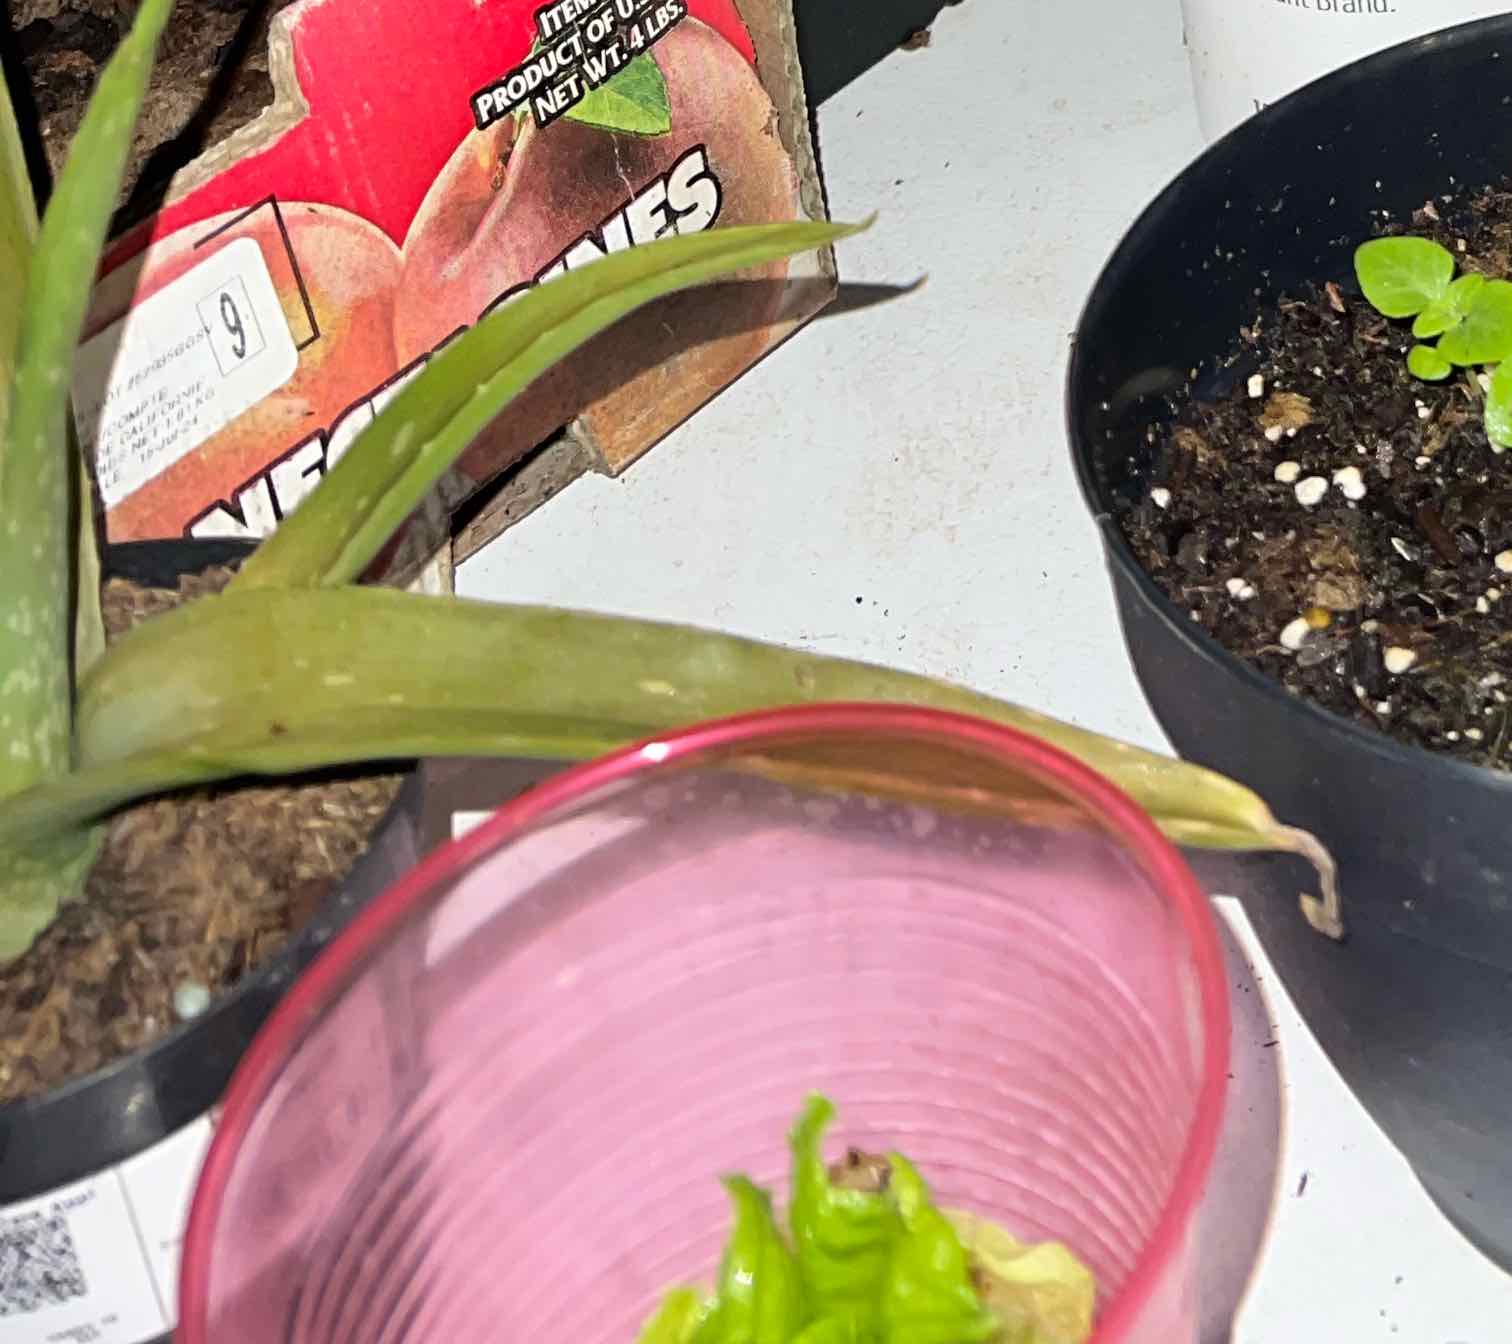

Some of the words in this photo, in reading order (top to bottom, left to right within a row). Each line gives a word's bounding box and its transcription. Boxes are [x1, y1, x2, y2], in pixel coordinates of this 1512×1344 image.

[476, 33, 581, 123] PRODUCT
[586, 13, 615, 43] OF
[535, 75, 580, 121] NET
[583, 42, 628, 83] WT.
[630, 24, 645, 49] 4
[219, 291, 246, 359] 9
